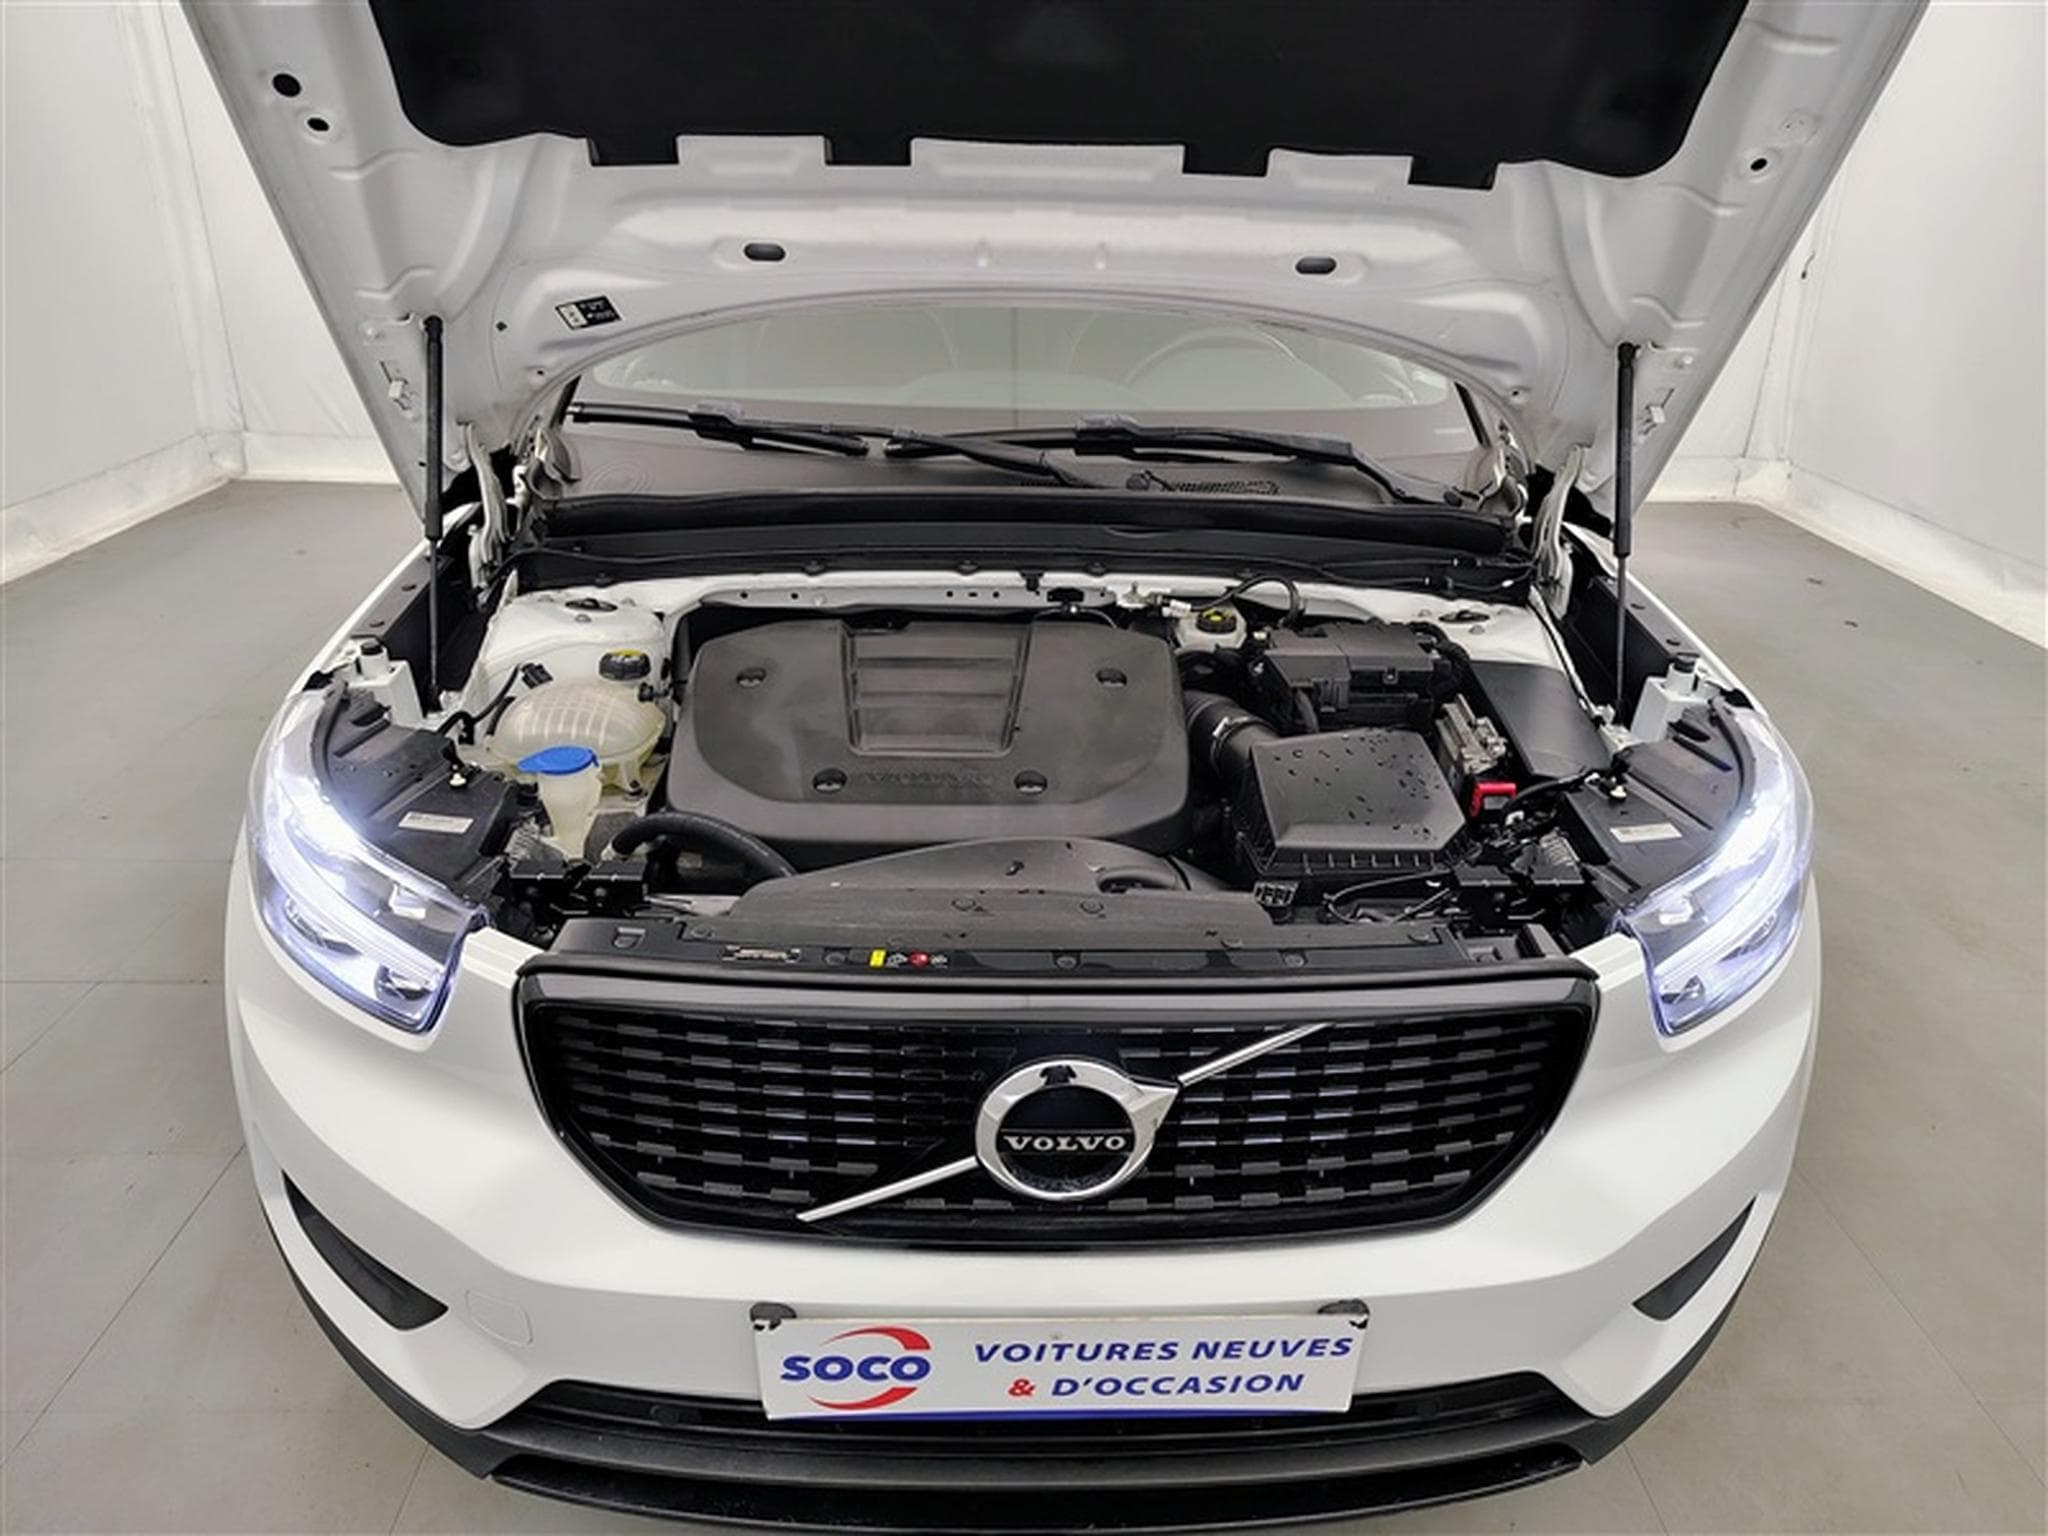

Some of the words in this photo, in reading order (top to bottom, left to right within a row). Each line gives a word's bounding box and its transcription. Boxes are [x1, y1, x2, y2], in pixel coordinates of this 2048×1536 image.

[1003, 1136, 1126, 1151] VOLVO
[975, 1343, 1179, 1362] VOITURES
[1192, 1338, 1354, 1360] NEUVES
[781, 1355, 932, 1382] SOCO
[1009, 1379, 1034, 1397] &
[1052, 1374, 1305, 1396] D'OCCASION
